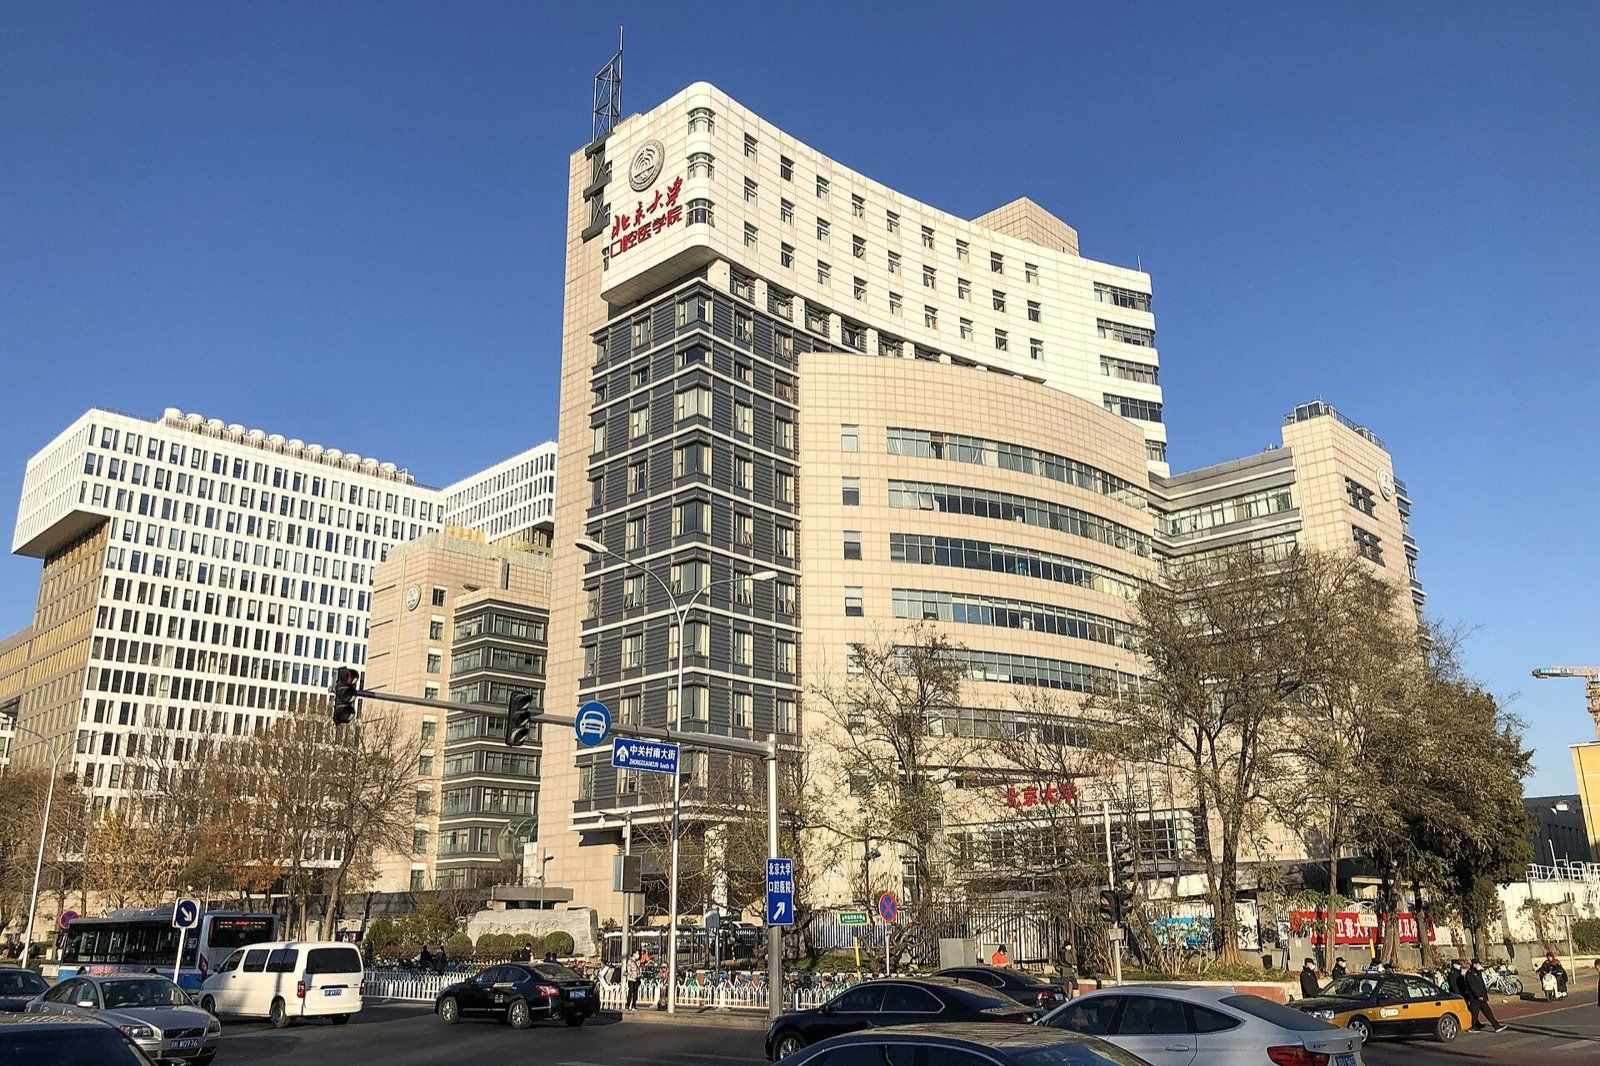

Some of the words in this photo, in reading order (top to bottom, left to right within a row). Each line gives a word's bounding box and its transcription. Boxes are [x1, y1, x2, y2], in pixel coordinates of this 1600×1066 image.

[611, 176, 683, 240] 北京大学
[610, 205, 683, 259] 口腔医学院
[630, 744, 676, 760] 中关村南大街
[769, 863, 790, 876] 北京大学
[769, 880, 791, 894] 口腔医院
